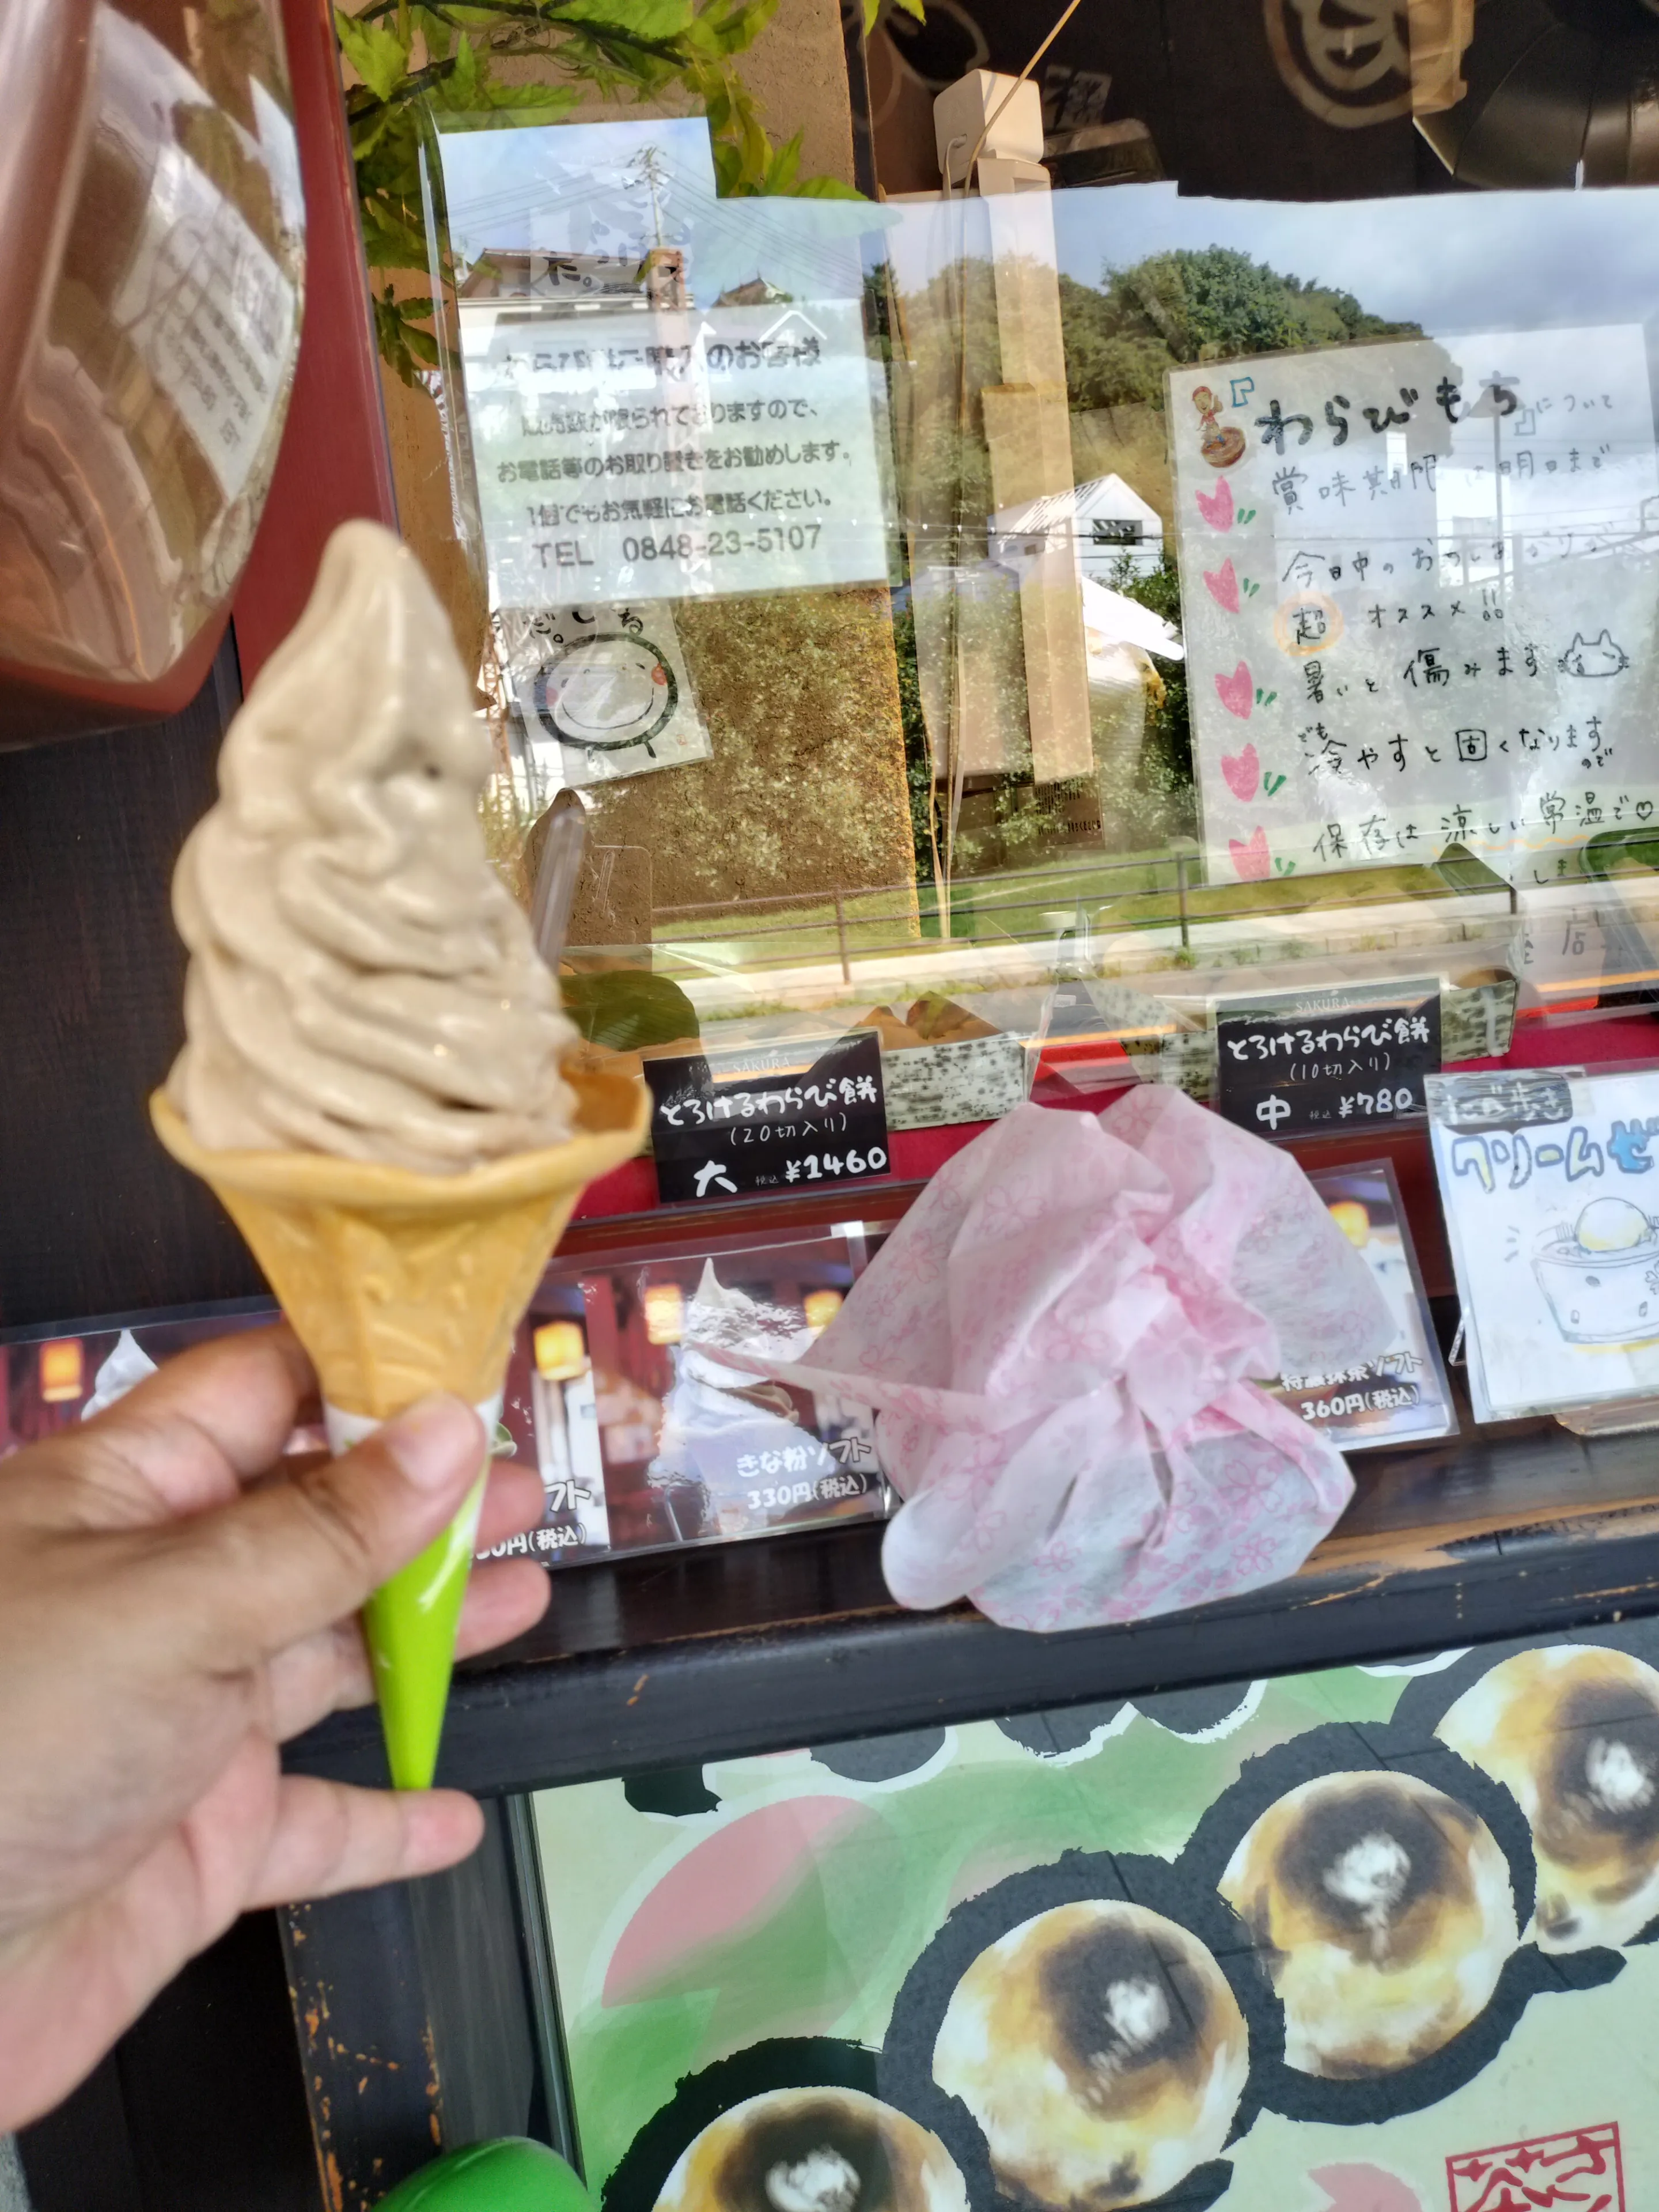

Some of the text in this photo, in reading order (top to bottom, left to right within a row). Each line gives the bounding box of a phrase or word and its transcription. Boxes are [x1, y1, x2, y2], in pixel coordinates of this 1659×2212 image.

[532, 524, 821, 569] TEL 0848-23-5107
[1293, 607, 1327, 645] 超
[1296, 997, 1351, 1012] SAKURA
[1227, 1016, 1429, 1061] とろけるわらび餅
[733, 1056, 791, 1073] SAKURA
[660, 1075, 877, 1127] とろけるわらび餅
[1256, 1095, 1291, 1130] 中
[1338, 1086, 1413, 1119] ¥780
[694, 1160, 737, 1198] 大
[785, 1146, 888, 1183] ¥1460
[1300, 1382, 1421, 1421] 360円(税込)
[736, 1437, 872, 1478] きな粉ソフト
[747, 1473, 867, 1510] 330円(税込)
